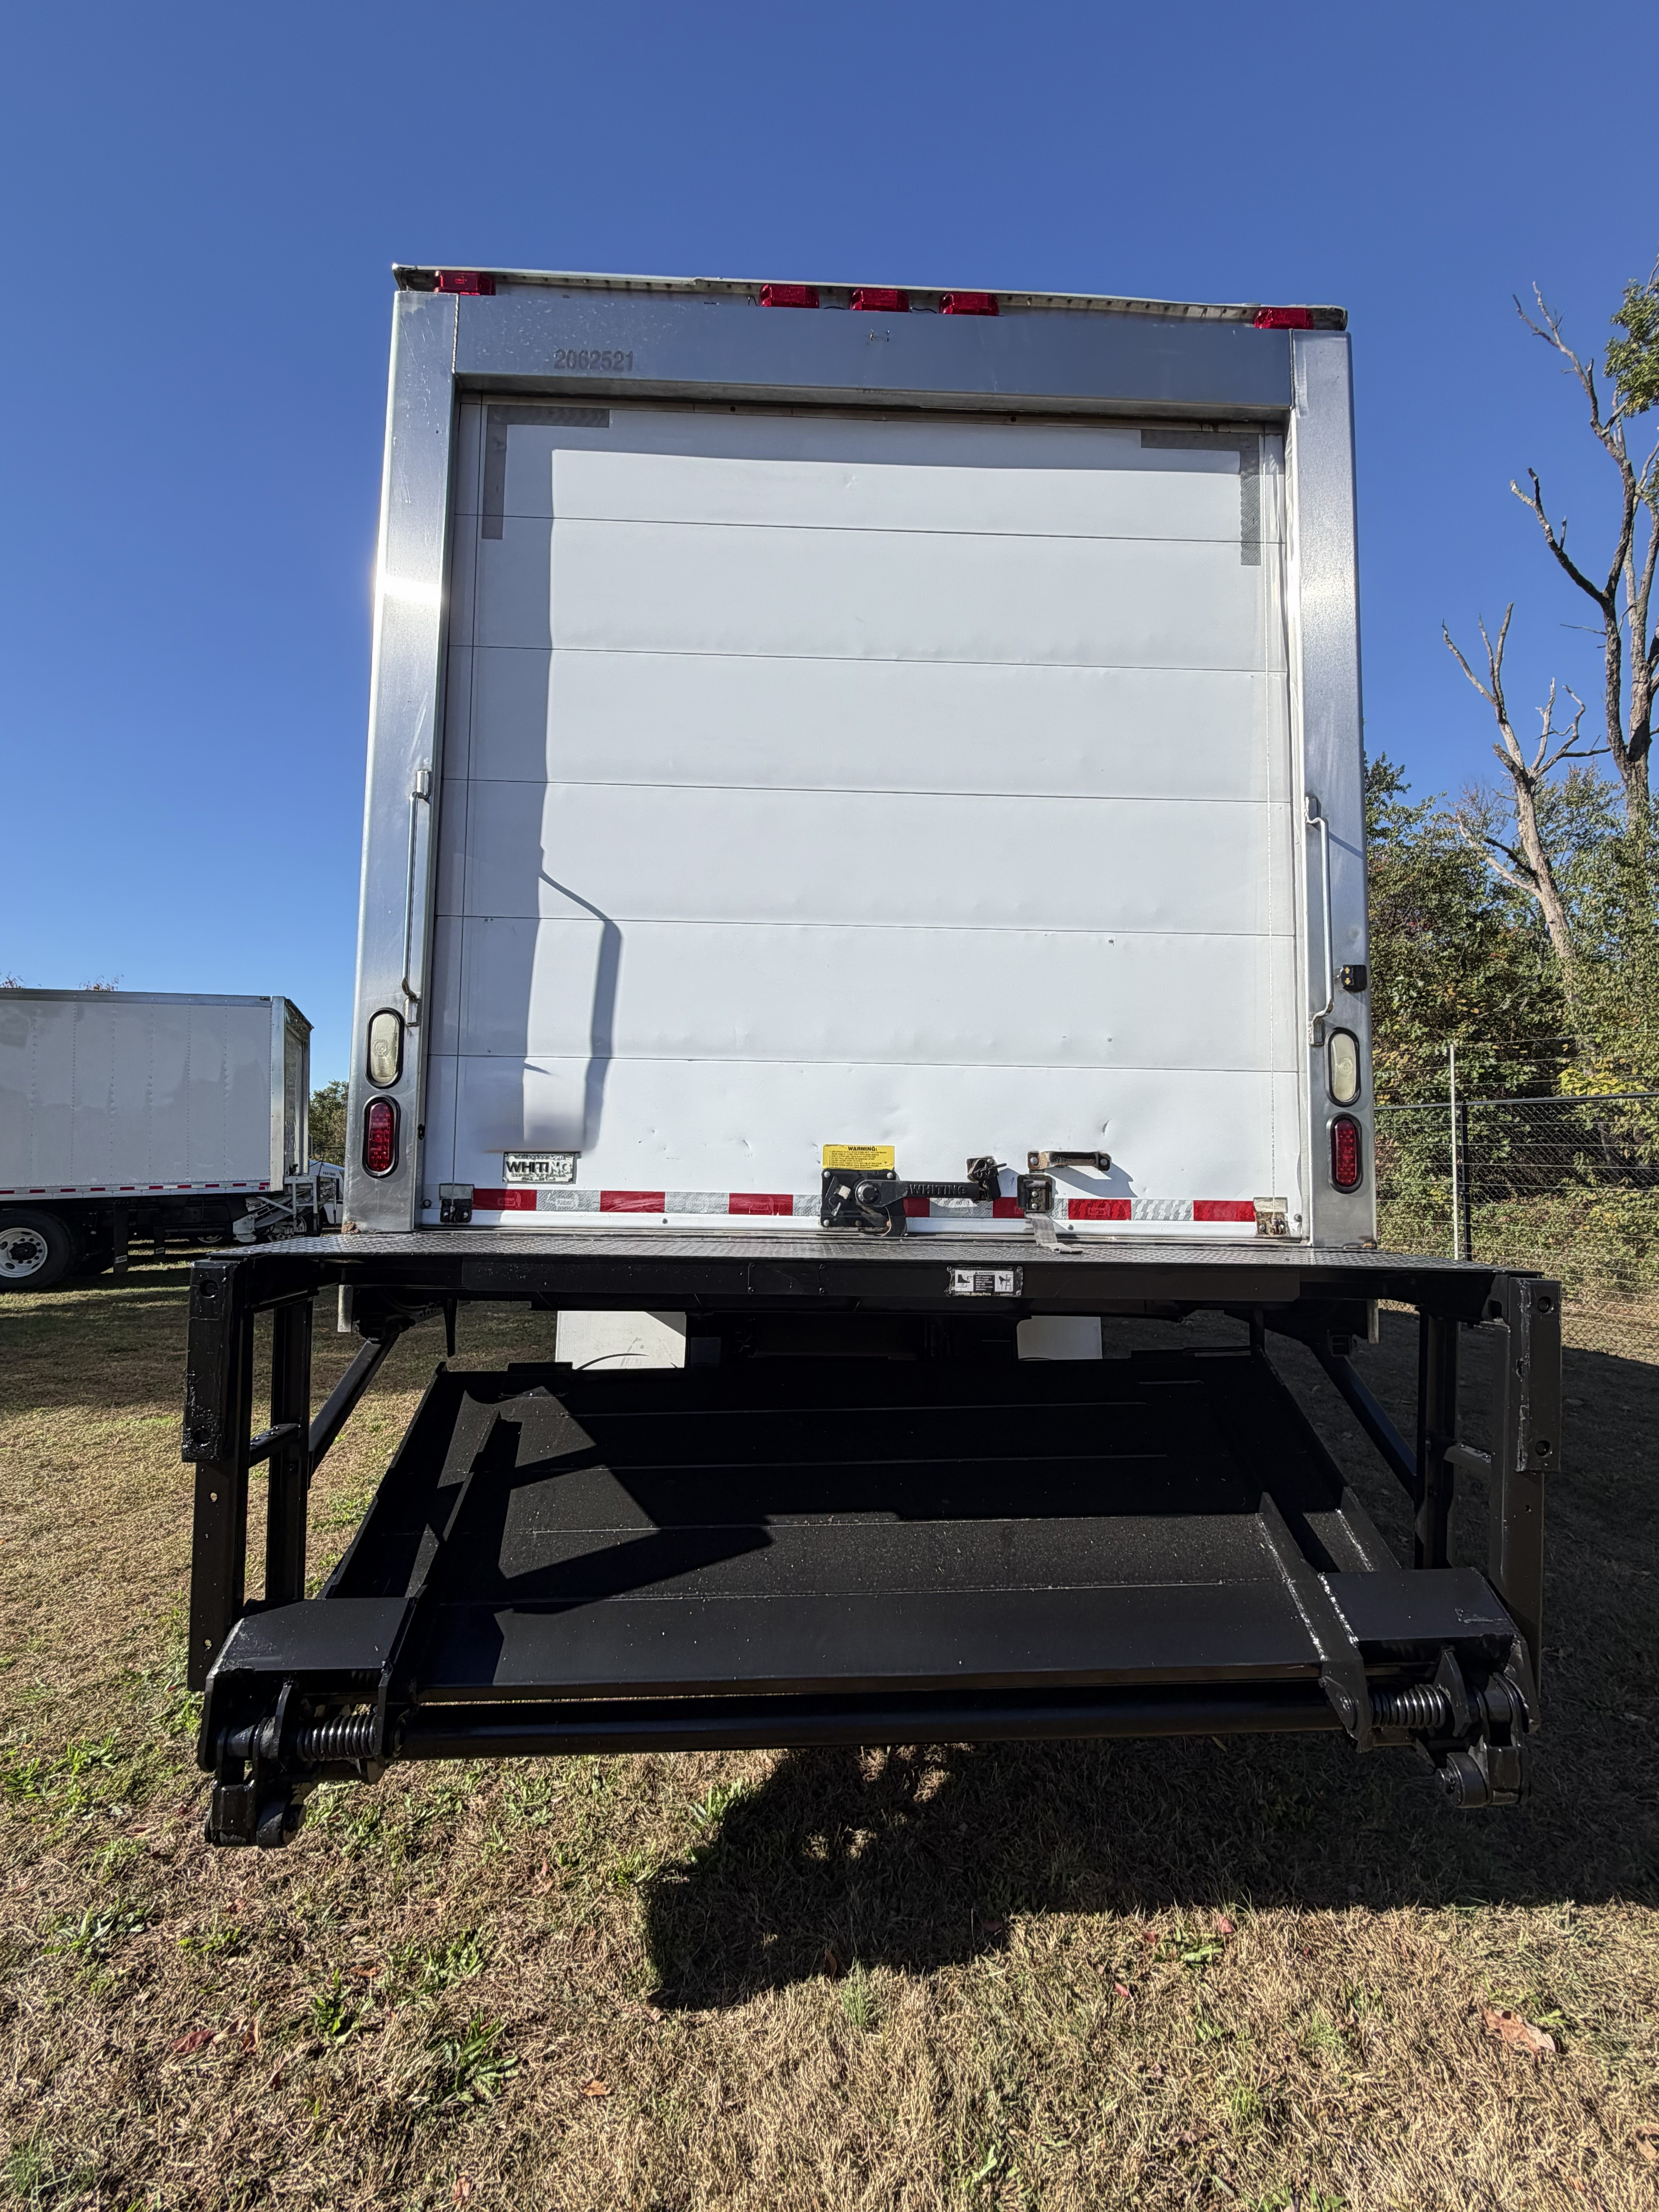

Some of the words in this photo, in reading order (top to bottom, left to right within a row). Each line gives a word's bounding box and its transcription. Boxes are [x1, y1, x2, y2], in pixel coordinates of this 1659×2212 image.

[554, 348, 633, 371] 2062521
[506, 1161, 573, 1174] WHITING
[910, 1184, 966, 1195] WHITING
